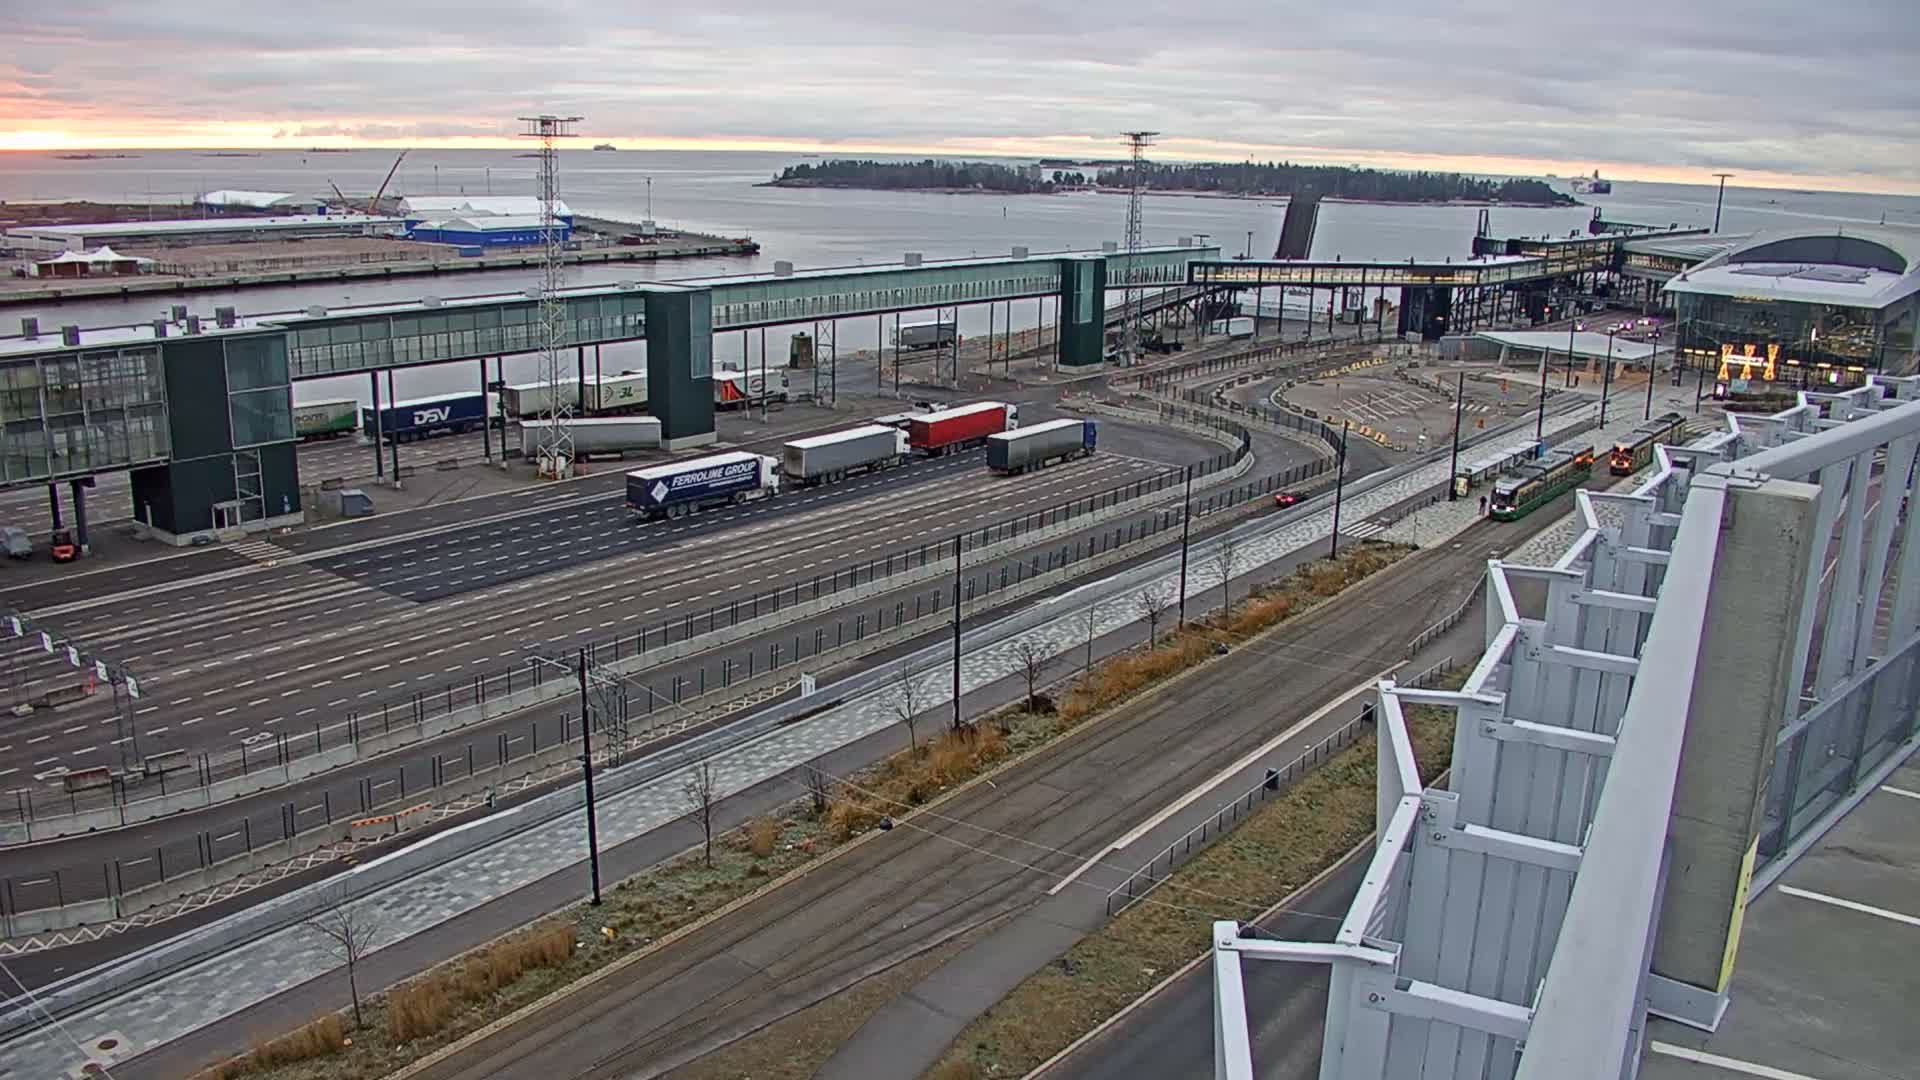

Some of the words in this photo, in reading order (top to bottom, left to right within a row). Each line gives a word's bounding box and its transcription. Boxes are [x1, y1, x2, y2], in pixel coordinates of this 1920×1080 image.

[414, 406, 451, 425] DSV
[672, 467, 723, 487] FERROLINE
[725, 461, 757, 476] GROUP
